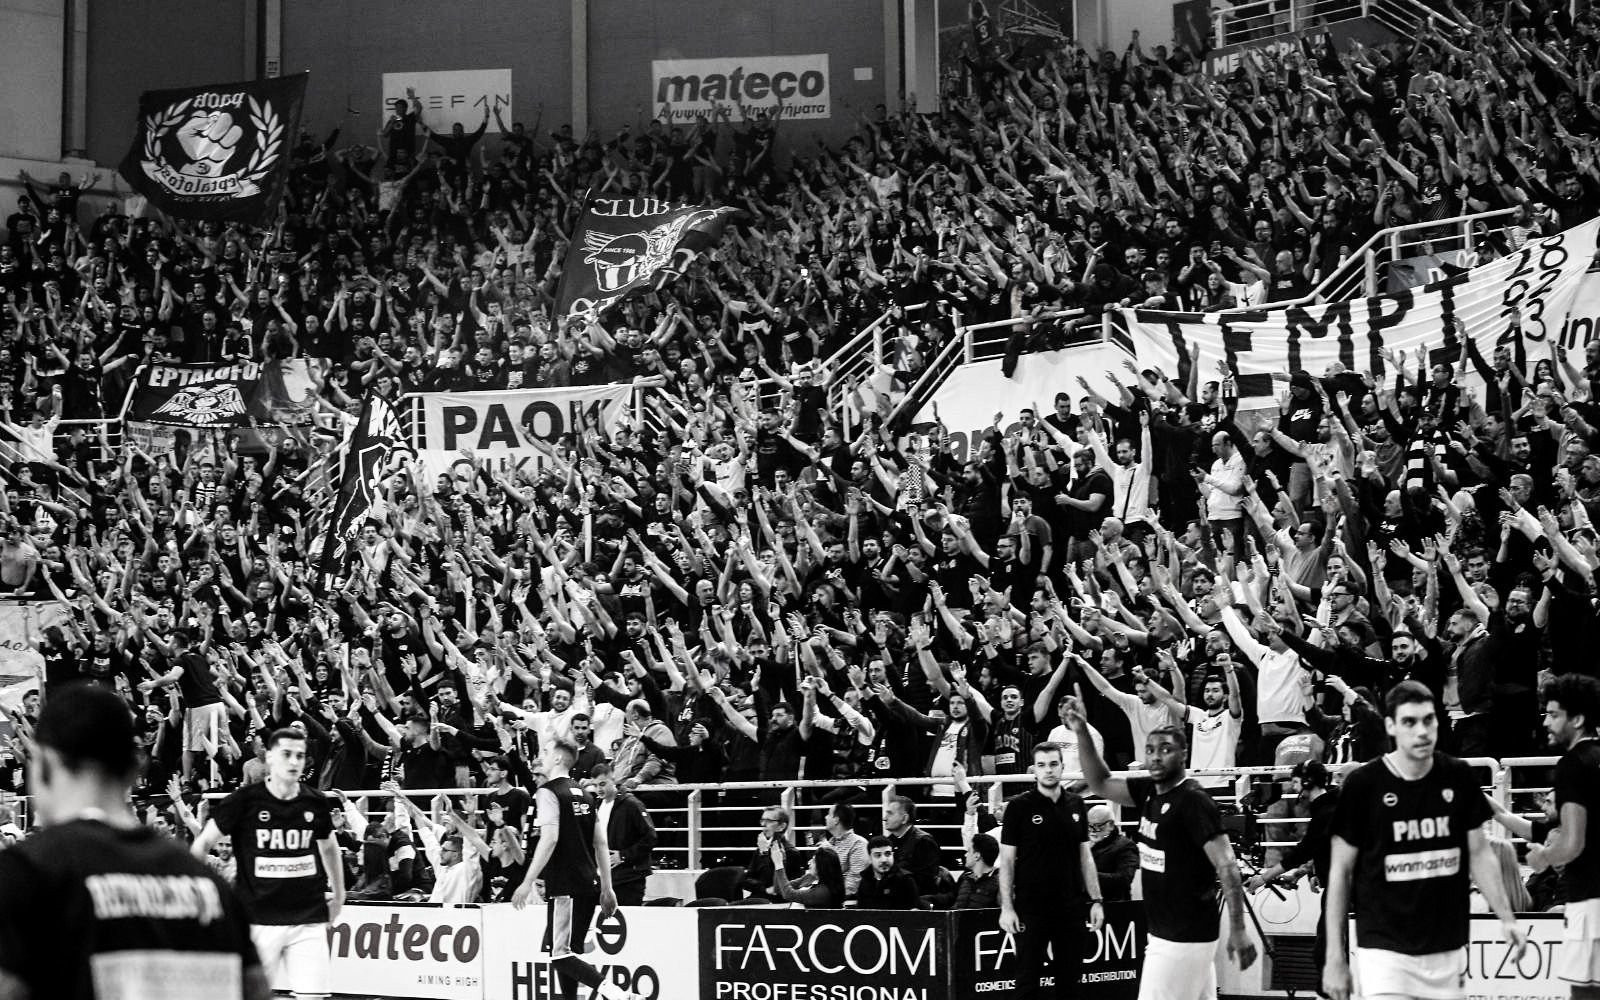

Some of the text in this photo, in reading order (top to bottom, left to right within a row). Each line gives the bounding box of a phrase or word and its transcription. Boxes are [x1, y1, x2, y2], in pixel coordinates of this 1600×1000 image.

[656, 66, 825, 103] mateco
[256, 828, 314, 850] PAOK
[1392, 815, 1451, 843] PAOK
[715, 923, 937, 976] FARCOM
[417, 975, 479, 987] AIMING HIGH
[1088, 969, 1137, 983] DISTRIBUTION
[715, 981, 927, 1000] PROFESSIONAL
